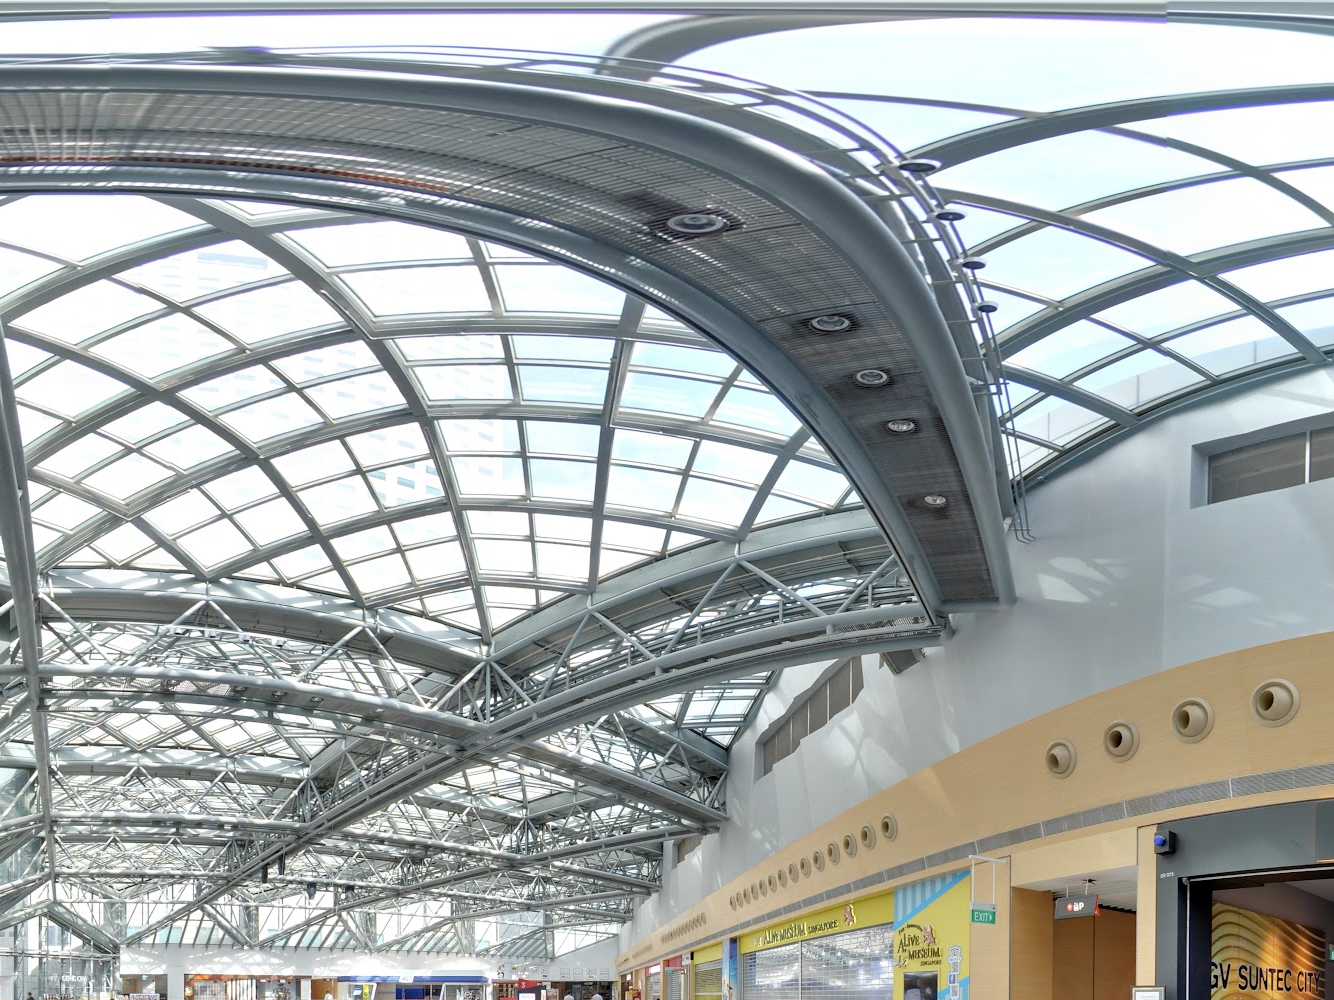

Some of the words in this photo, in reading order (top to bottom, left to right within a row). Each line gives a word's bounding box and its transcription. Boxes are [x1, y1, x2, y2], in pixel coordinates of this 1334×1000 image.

[974, 912, 989, 921] EXIT
[1238, 965, 1292, 991] SUNTEC
[1296, 970, 1320, 993] CITY
